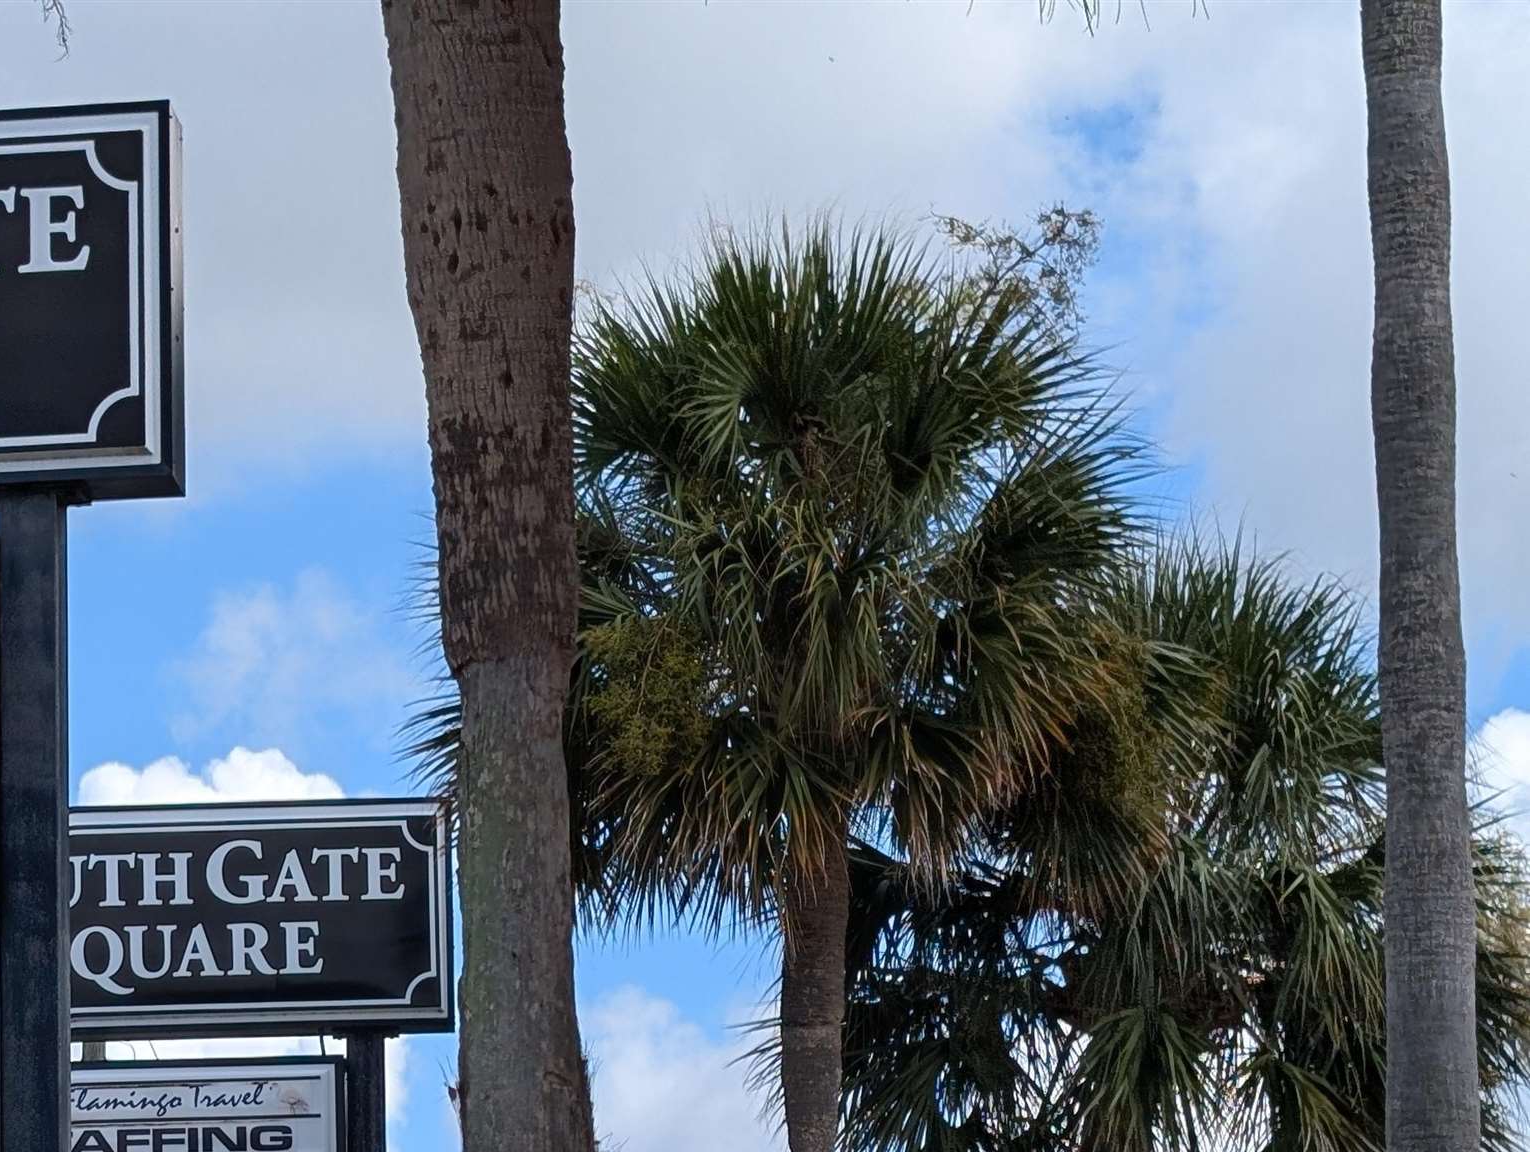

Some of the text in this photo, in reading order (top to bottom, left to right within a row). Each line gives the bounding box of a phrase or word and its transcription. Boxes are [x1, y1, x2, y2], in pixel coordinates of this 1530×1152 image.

[206, 840, 405, 904] GATE
[70, 921, 323, 996] QUARE
[189, 1083, 264, 1109] Travel
